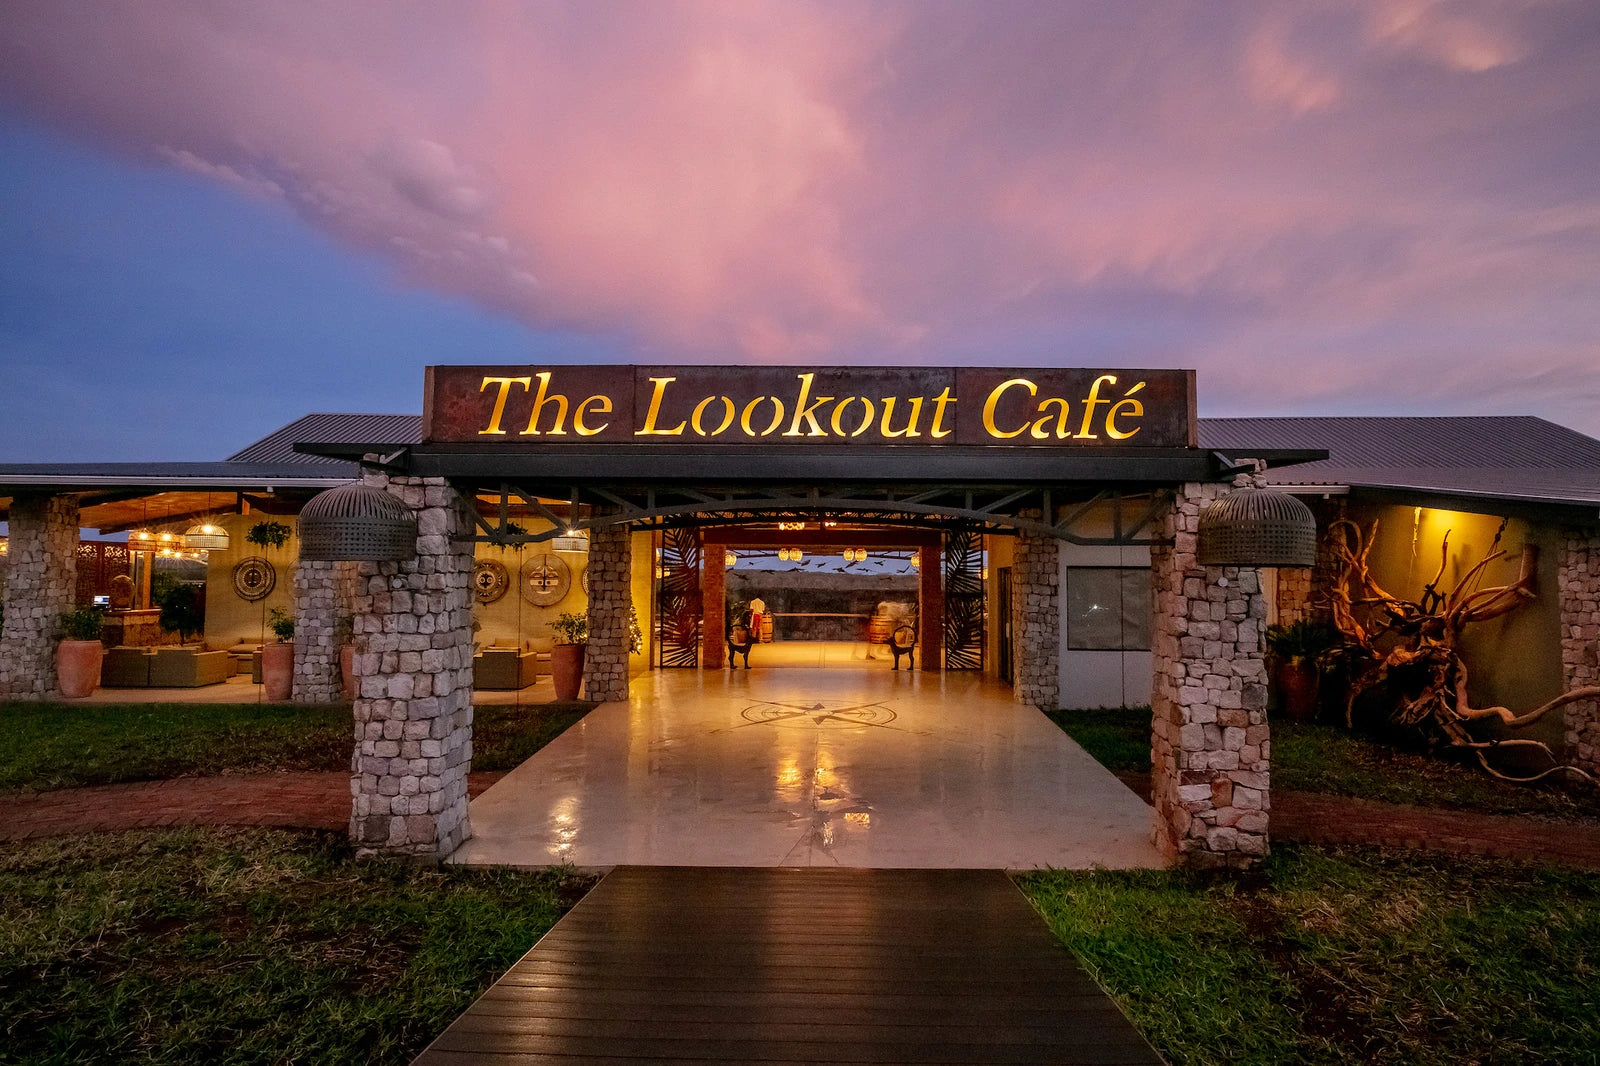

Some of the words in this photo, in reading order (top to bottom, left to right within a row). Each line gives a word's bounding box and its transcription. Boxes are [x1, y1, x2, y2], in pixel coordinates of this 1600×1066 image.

[477, 371, 613, 437] The
[634, 372, 958, 439] Lookout
[982, 374, 1148, 440] Café
